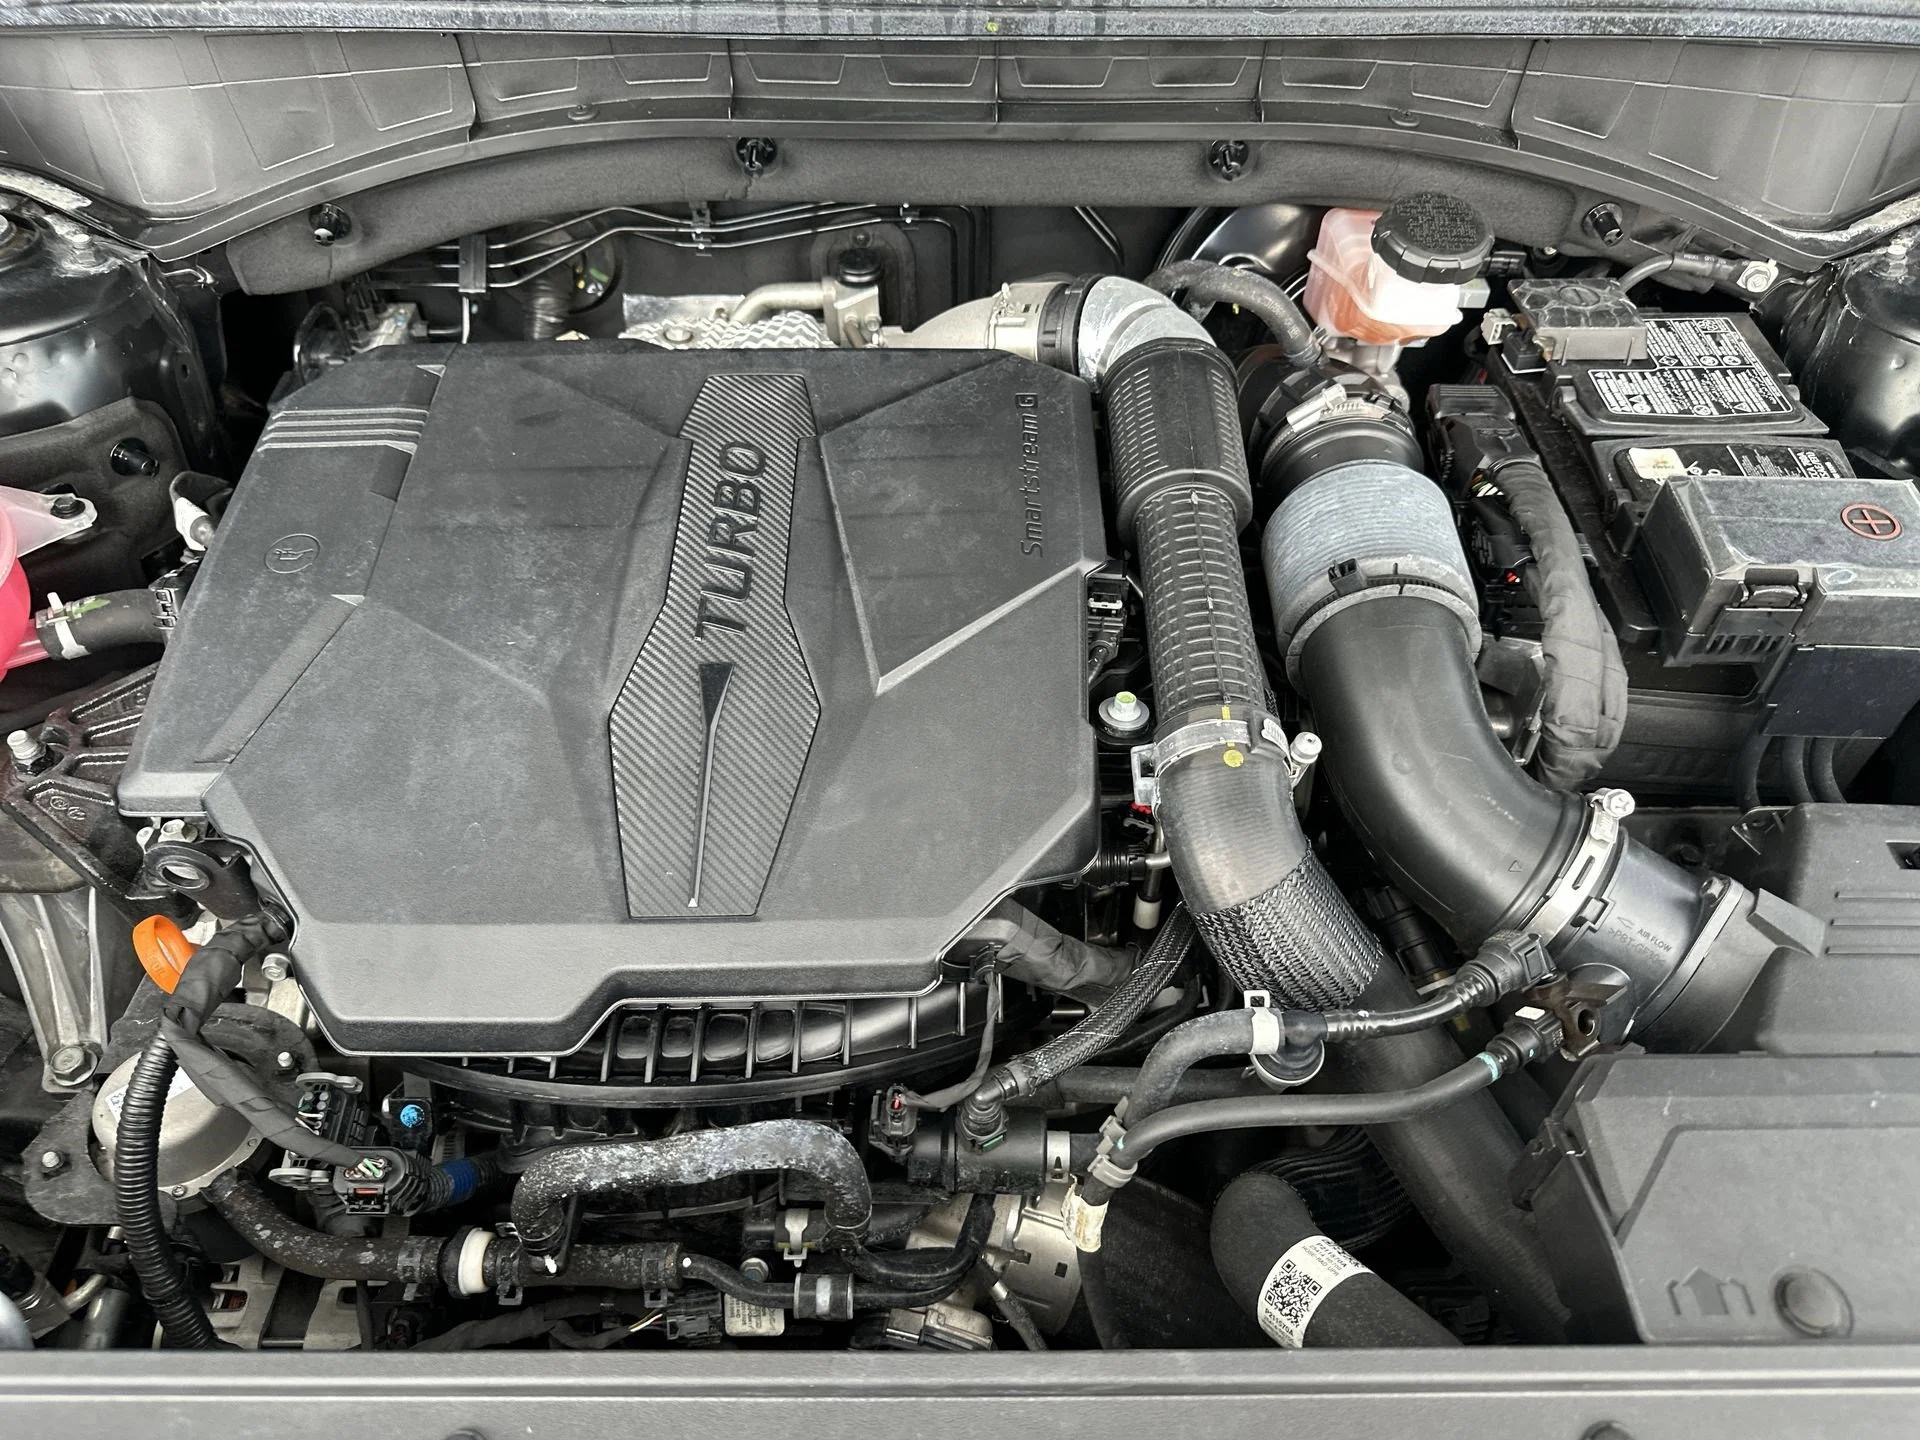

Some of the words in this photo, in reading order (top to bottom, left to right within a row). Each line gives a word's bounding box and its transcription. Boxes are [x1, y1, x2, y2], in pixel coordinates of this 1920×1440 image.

[694, 441, 766, 642] TURBO
[1018, 413, 1044, 558] Smartstream
[1637, 928, 1651, 940] AIR
[1650, 935, 1673, 952] FLOW
